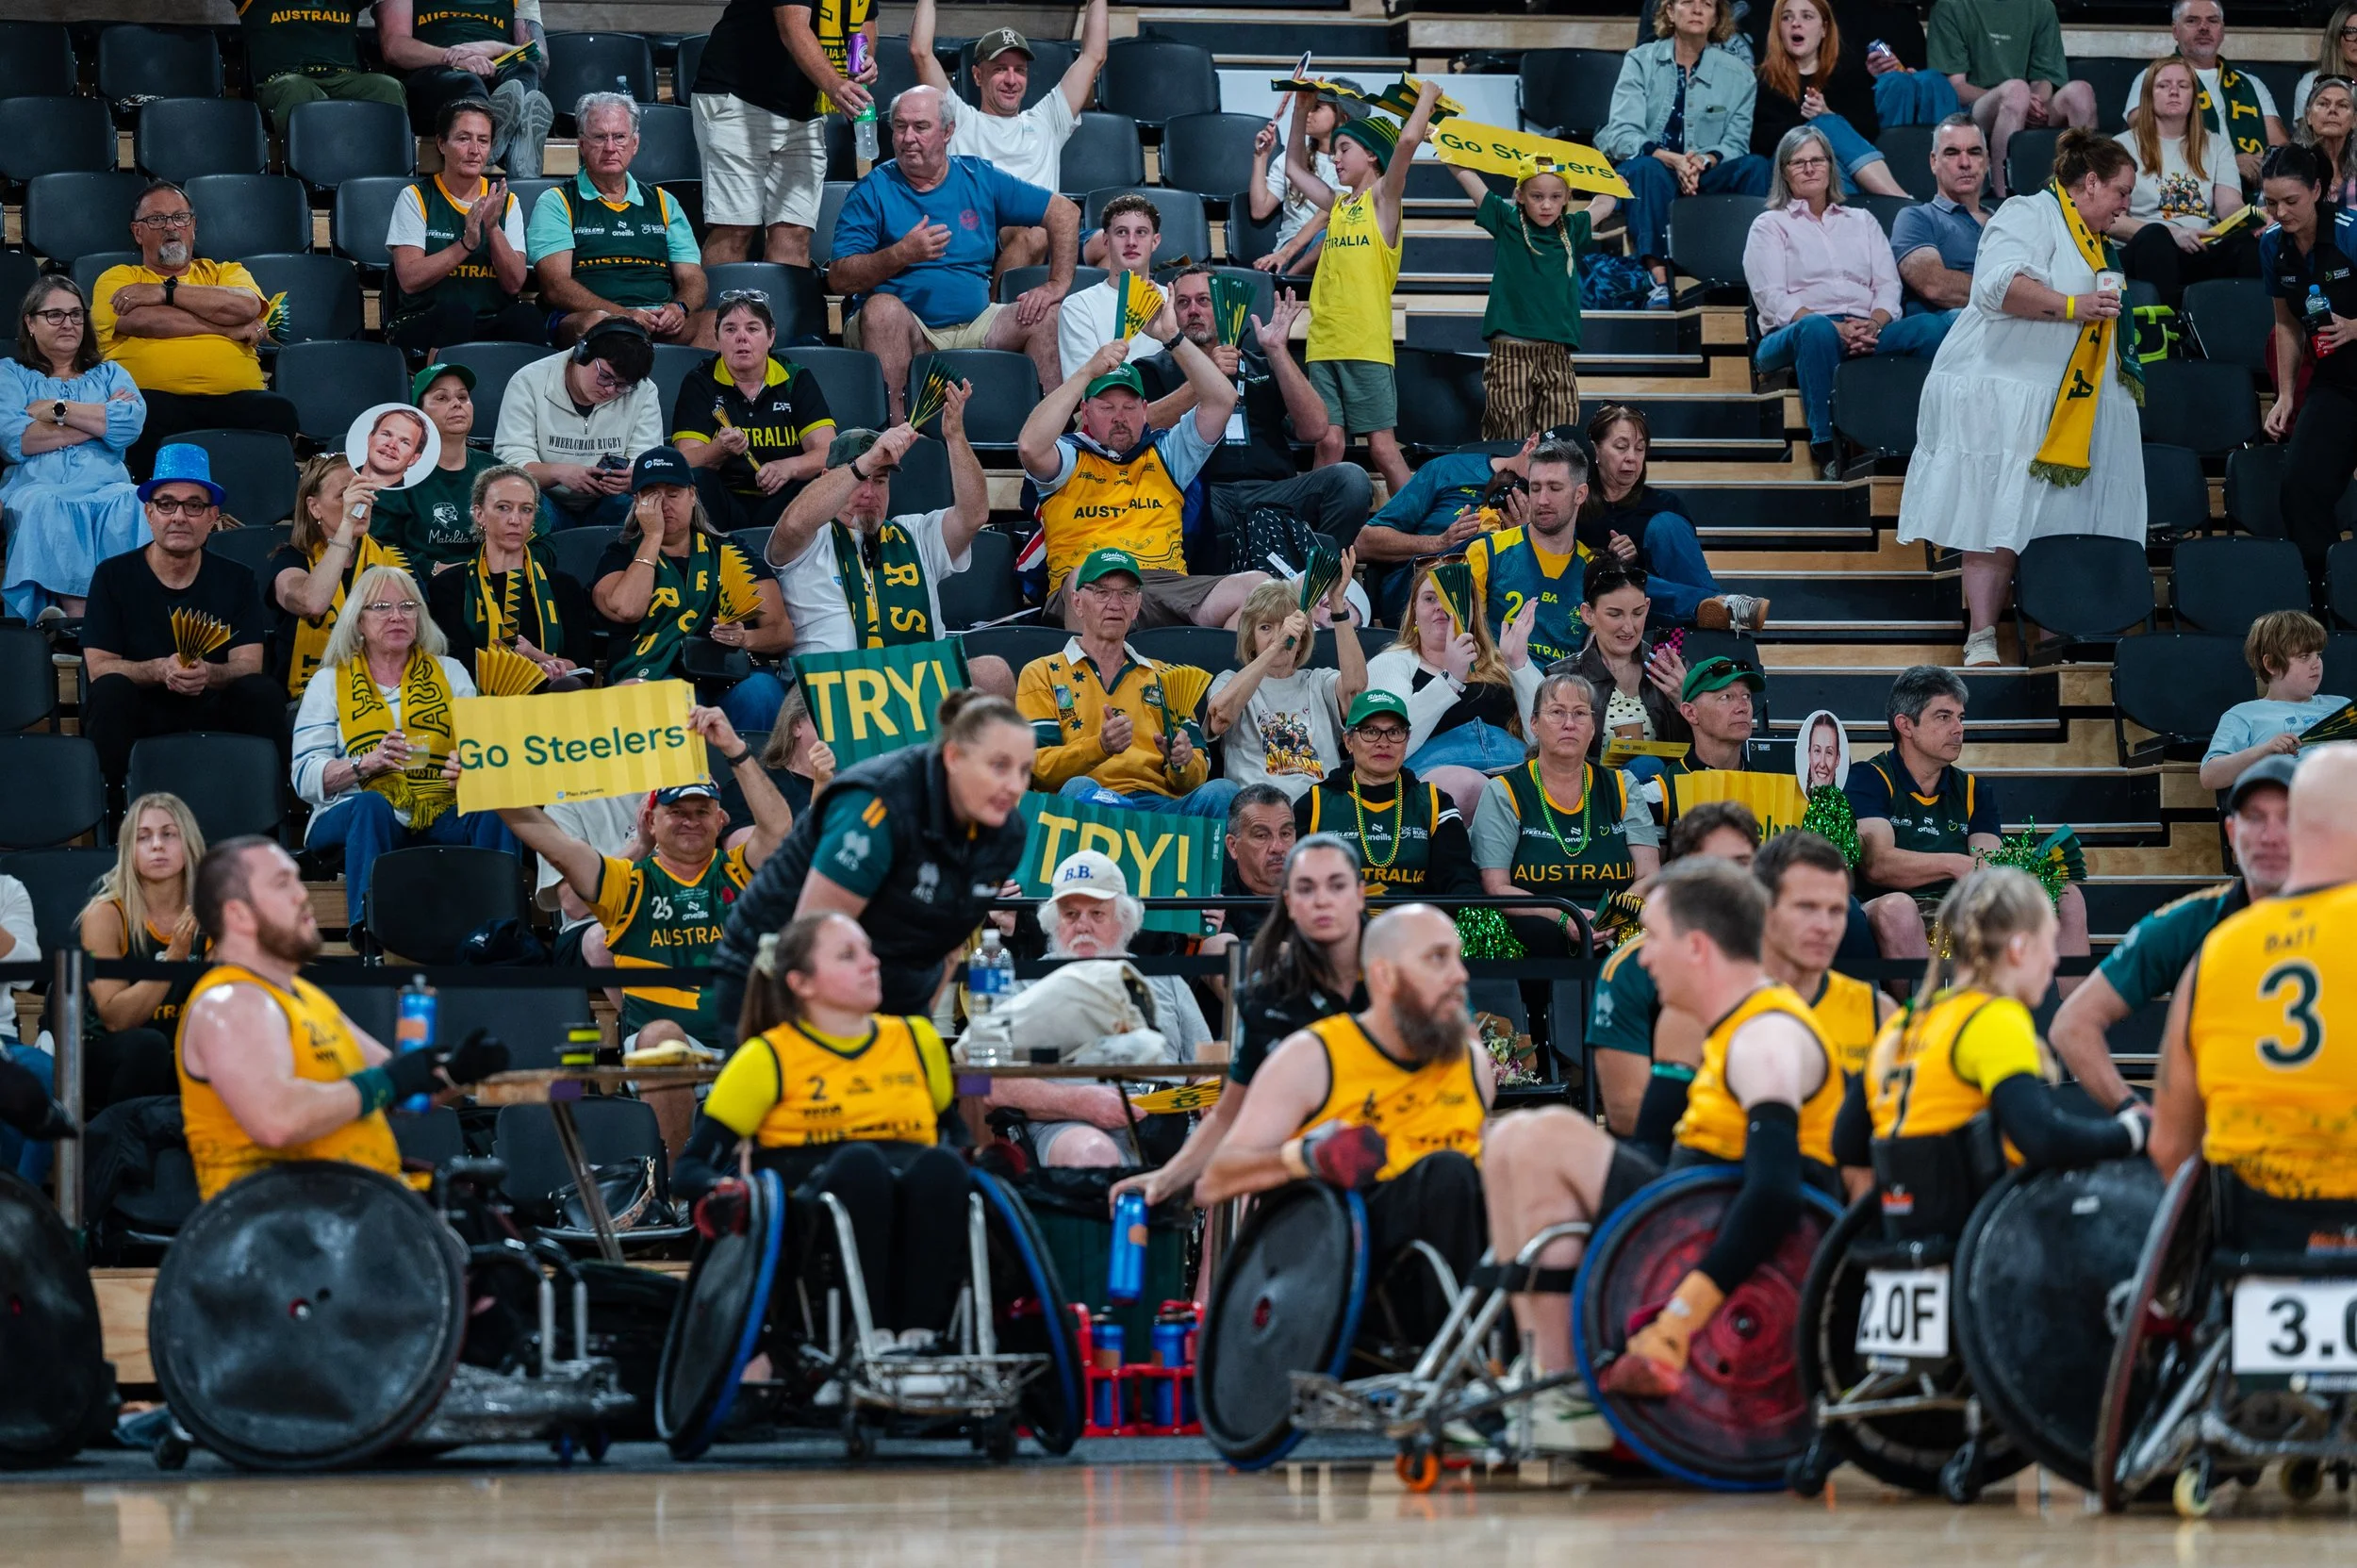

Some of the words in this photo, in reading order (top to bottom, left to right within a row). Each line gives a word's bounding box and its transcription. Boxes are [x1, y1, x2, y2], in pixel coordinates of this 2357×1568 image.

[270, 9, 351, 25] AUSTRALIA
[1440, 133, 1482, 153] Go
[1492, 143, 1615, 179] Sters
[549, 435, 595, 451] WHEELCHAIR
[597, 437, 622, 450] RUGBY
[1101, 552, 1129, 562] Steelers
[1504, 591, 1525, 624] 2
[459, 738, 509, 770] Go
[523, 725, 686, 766] Steelers
[1063, 866, 1094, 883] B.B.
[1360, 867, 1426, 883] TRALIA
[651, 896, 674, 920] 26
[650, 925, 724, 949] AUSTRA
[2258, 959, 2325, 1069] 3
[807, 1075, 828, 1101] 2
